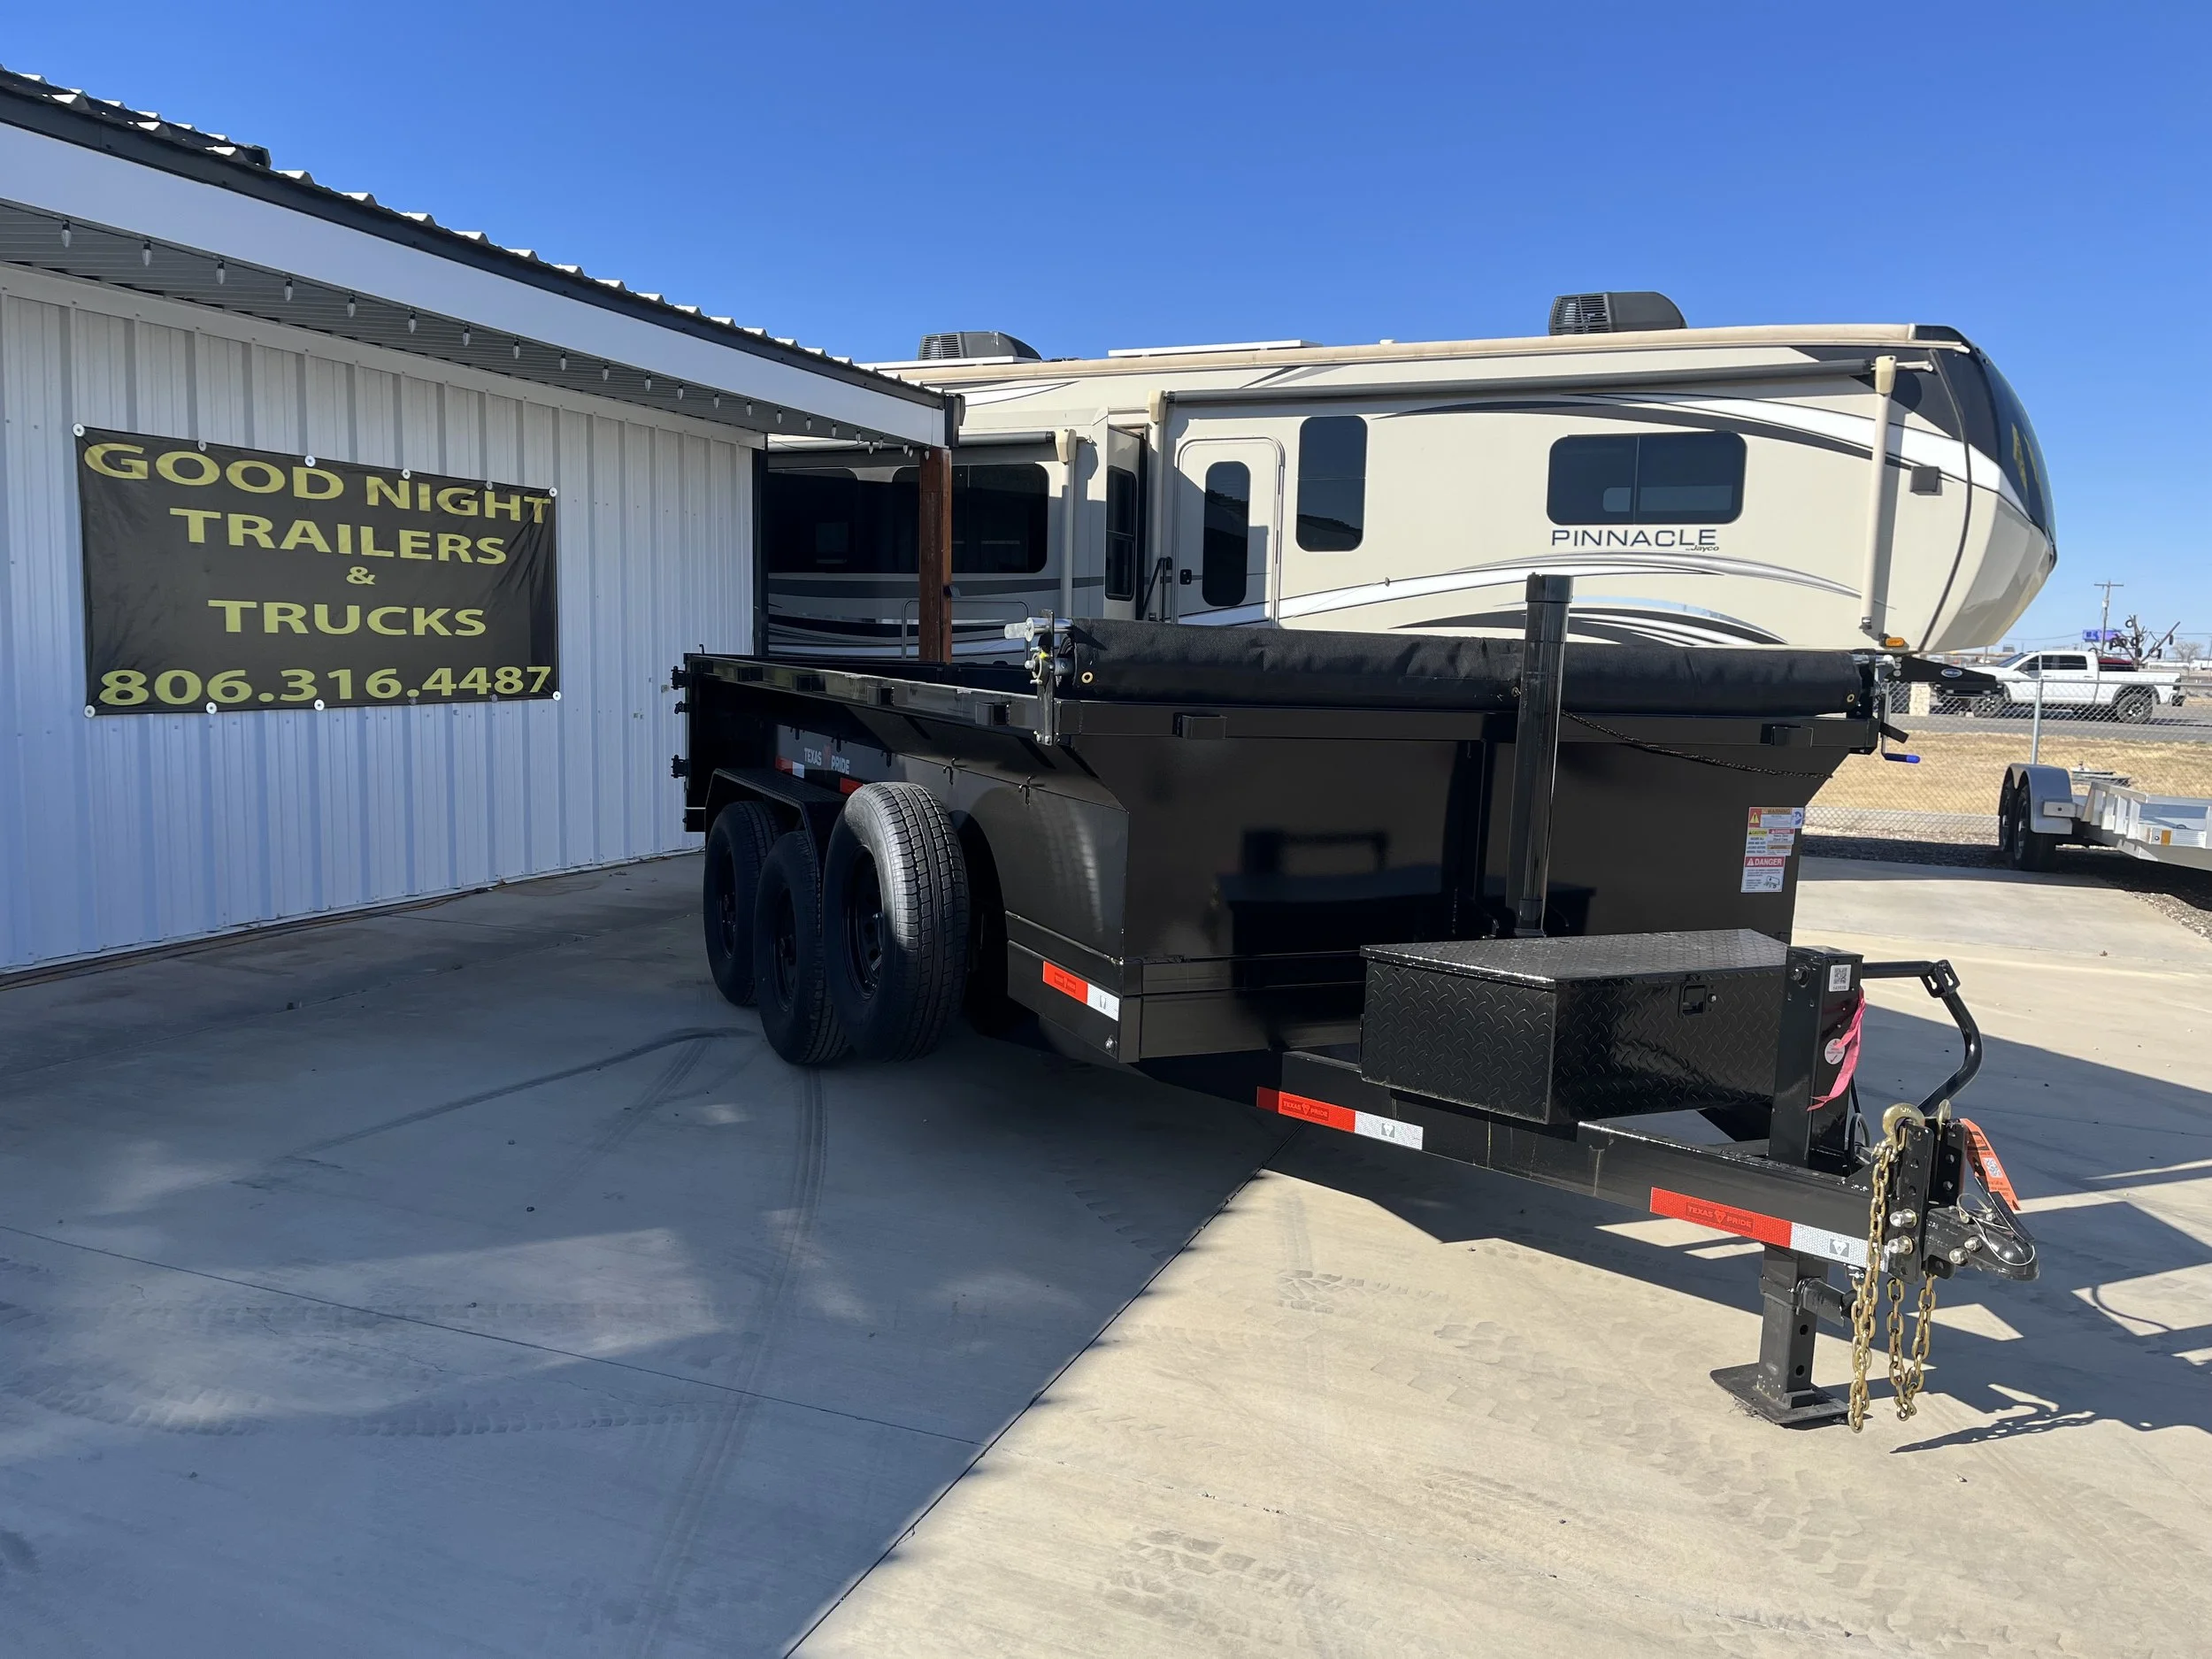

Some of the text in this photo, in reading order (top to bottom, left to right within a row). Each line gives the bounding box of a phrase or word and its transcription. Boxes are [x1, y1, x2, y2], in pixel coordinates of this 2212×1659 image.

[84, 442, 551, 524] GOOD NIGHT
[169, 507, 507, 565] TRAILERS
[1551, 529, 1717, 547] PINNACLE
[346, 566, 375, 585] &
[207, 599, 488, 636] TRUCKS
[98, 665, 551, 706] 806.316.4487
[803, 747, 850, 775] TEXAS PRIDE
[1283, 1101, 1302, 1111] TEXAS
[1687, 1205, 1753, 1228] TEXAS PRIDE
